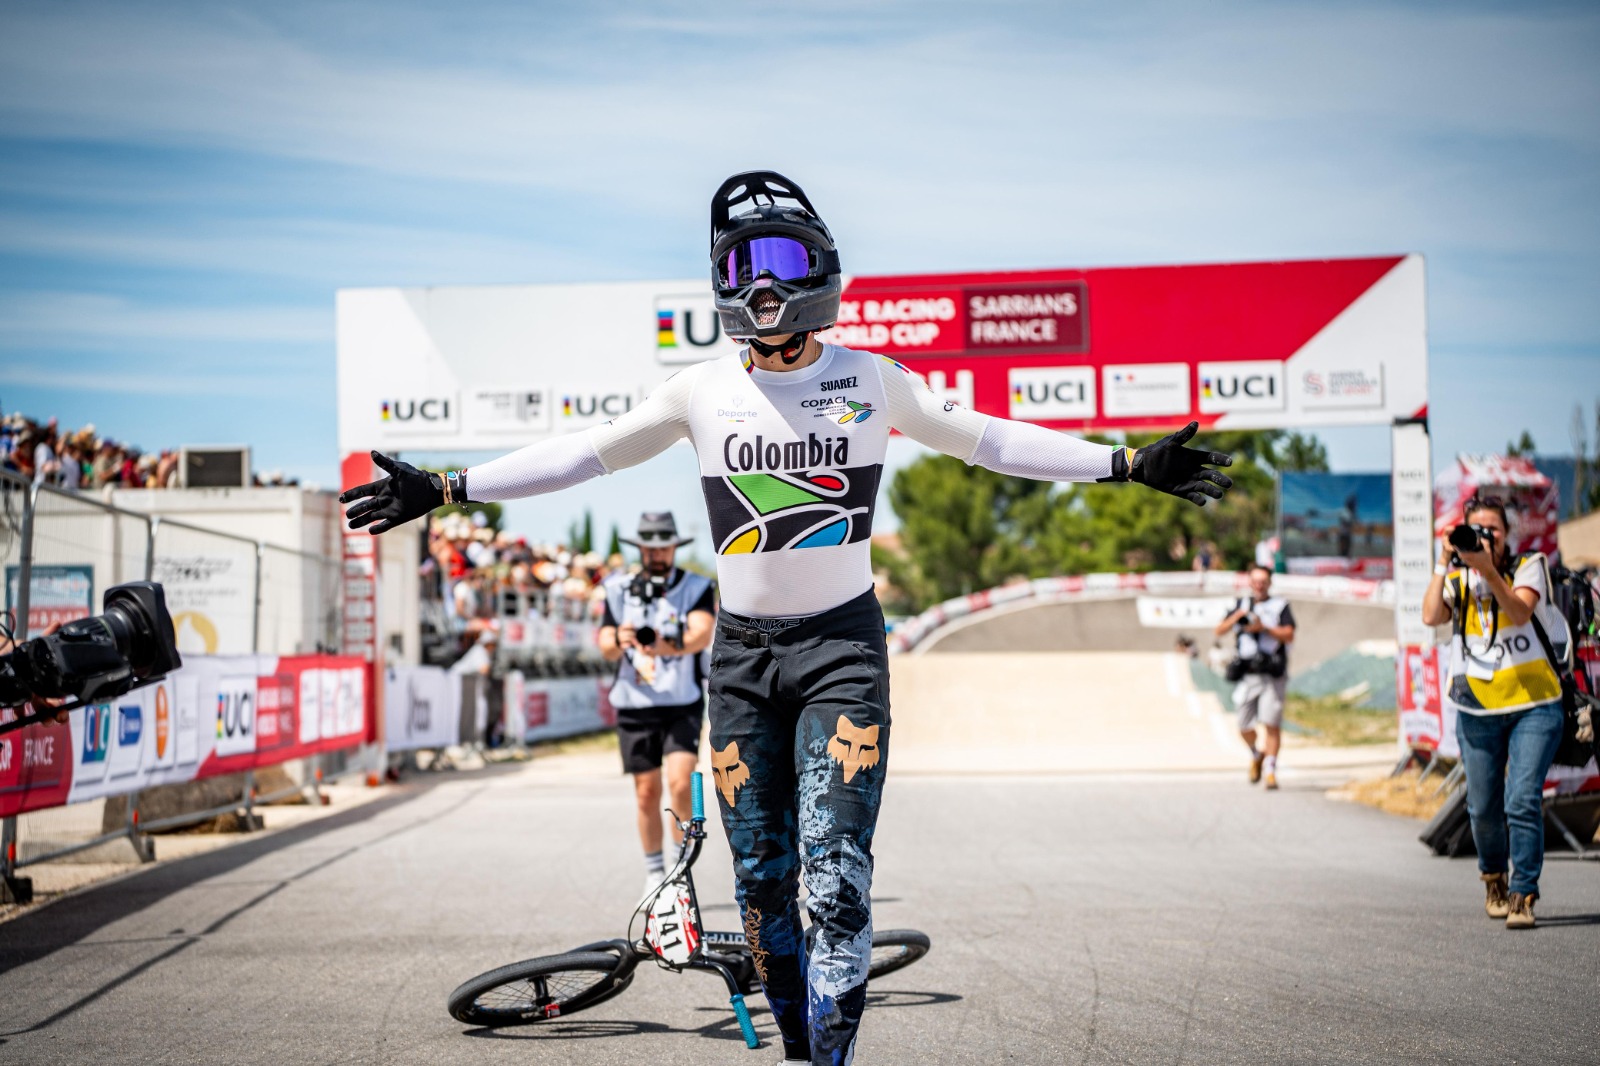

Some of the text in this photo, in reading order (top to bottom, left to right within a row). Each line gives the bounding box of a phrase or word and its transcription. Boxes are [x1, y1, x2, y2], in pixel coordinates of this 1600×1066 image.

[863, 297, 956, 323] RACING
[969, 292, 1078, 319] SARRIANS
[891, 321, 941, 347] CUP
[970, 318, 1058, 343] FRANCE
[820, 376, 858, 392] SUAREZ
[1027, 381, 1085, 404] UCI
[1217, 375, 1276, 398] UCI
[394, 399, 449, 421] UCI
[575, 395, 632, 416] UCI
[801, 396, 846, 408] COPACI
[717, 409, 758, 419] Deporte
[724, 433, 849, 472] Colombia
[24, 735, 55, 768] FRANCE
